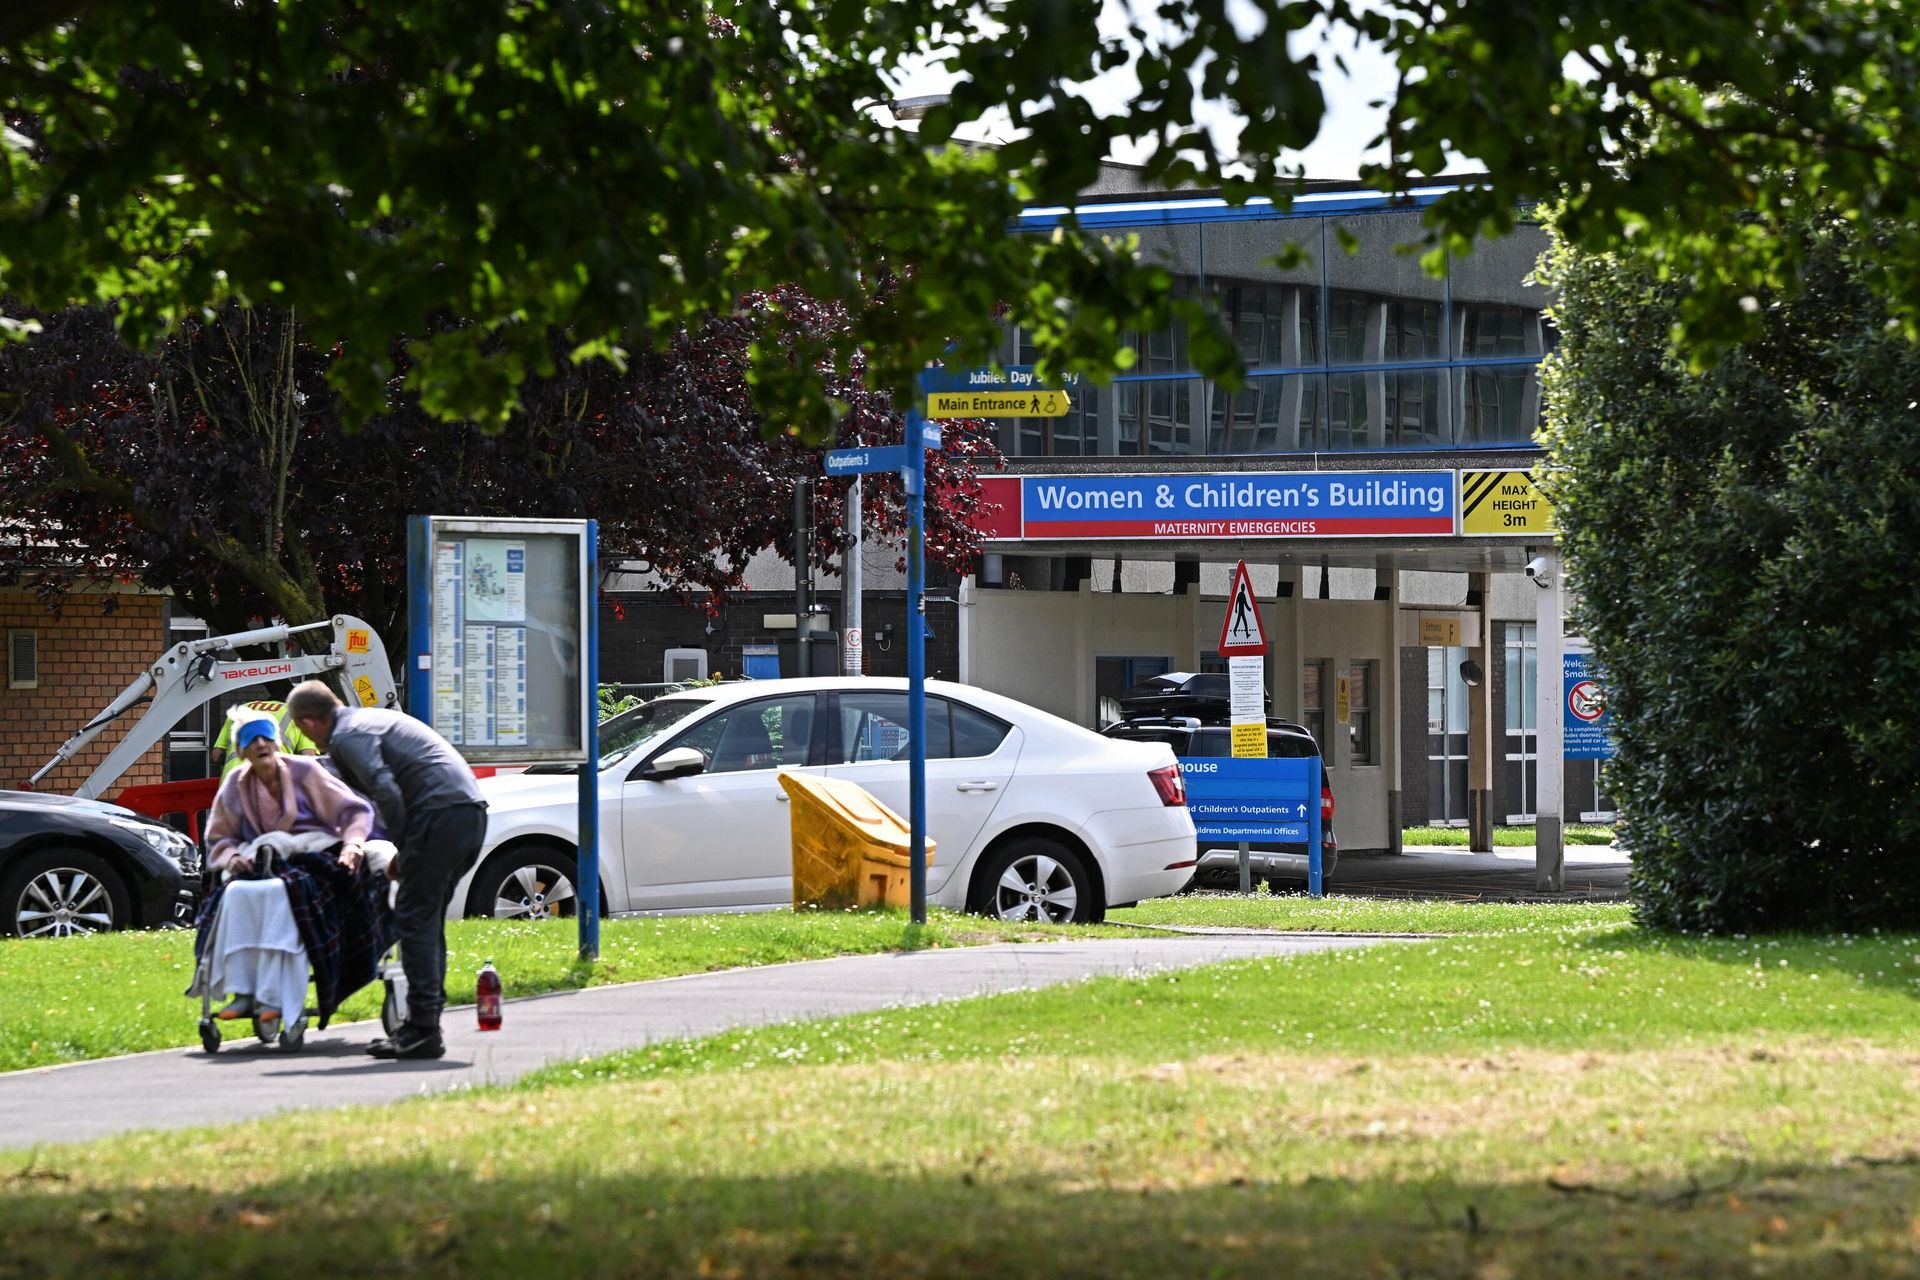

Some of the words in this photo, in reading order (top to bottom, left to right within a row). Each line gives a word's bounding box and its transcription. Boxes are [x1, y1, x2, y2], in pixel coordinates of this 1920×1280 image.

[1010, 371, 1033, 386] Day
[938, 398, 969, 410] Main
[972, 398, 1026, 410] Entrance
[828, 454, 863, 470] Outpatients
[864, 453, 869, 465] 3
[1037, 485, 1143, 510] Women
[1154, 484, 1175, 509] &
[1329, 480, 1444, 513] Building
[1501, 485, 1528, 496] MAX
[1492, 500, 1538, 511] HEIGHT
[1503, 513, 1527, 527] 3m
[1154, 522, 1226, 535] MATERNITY
[1229, 521, 1316, 534] EMERGENCIES
[348, 631, 367, 651] jfw
[1198, 805, 1239, 813] Children's
[1240, 805, 1290, 815] Outpatients
[1223, 827, 1273, 836] Departmental
[1273, 827, 1299, 835] Offices
